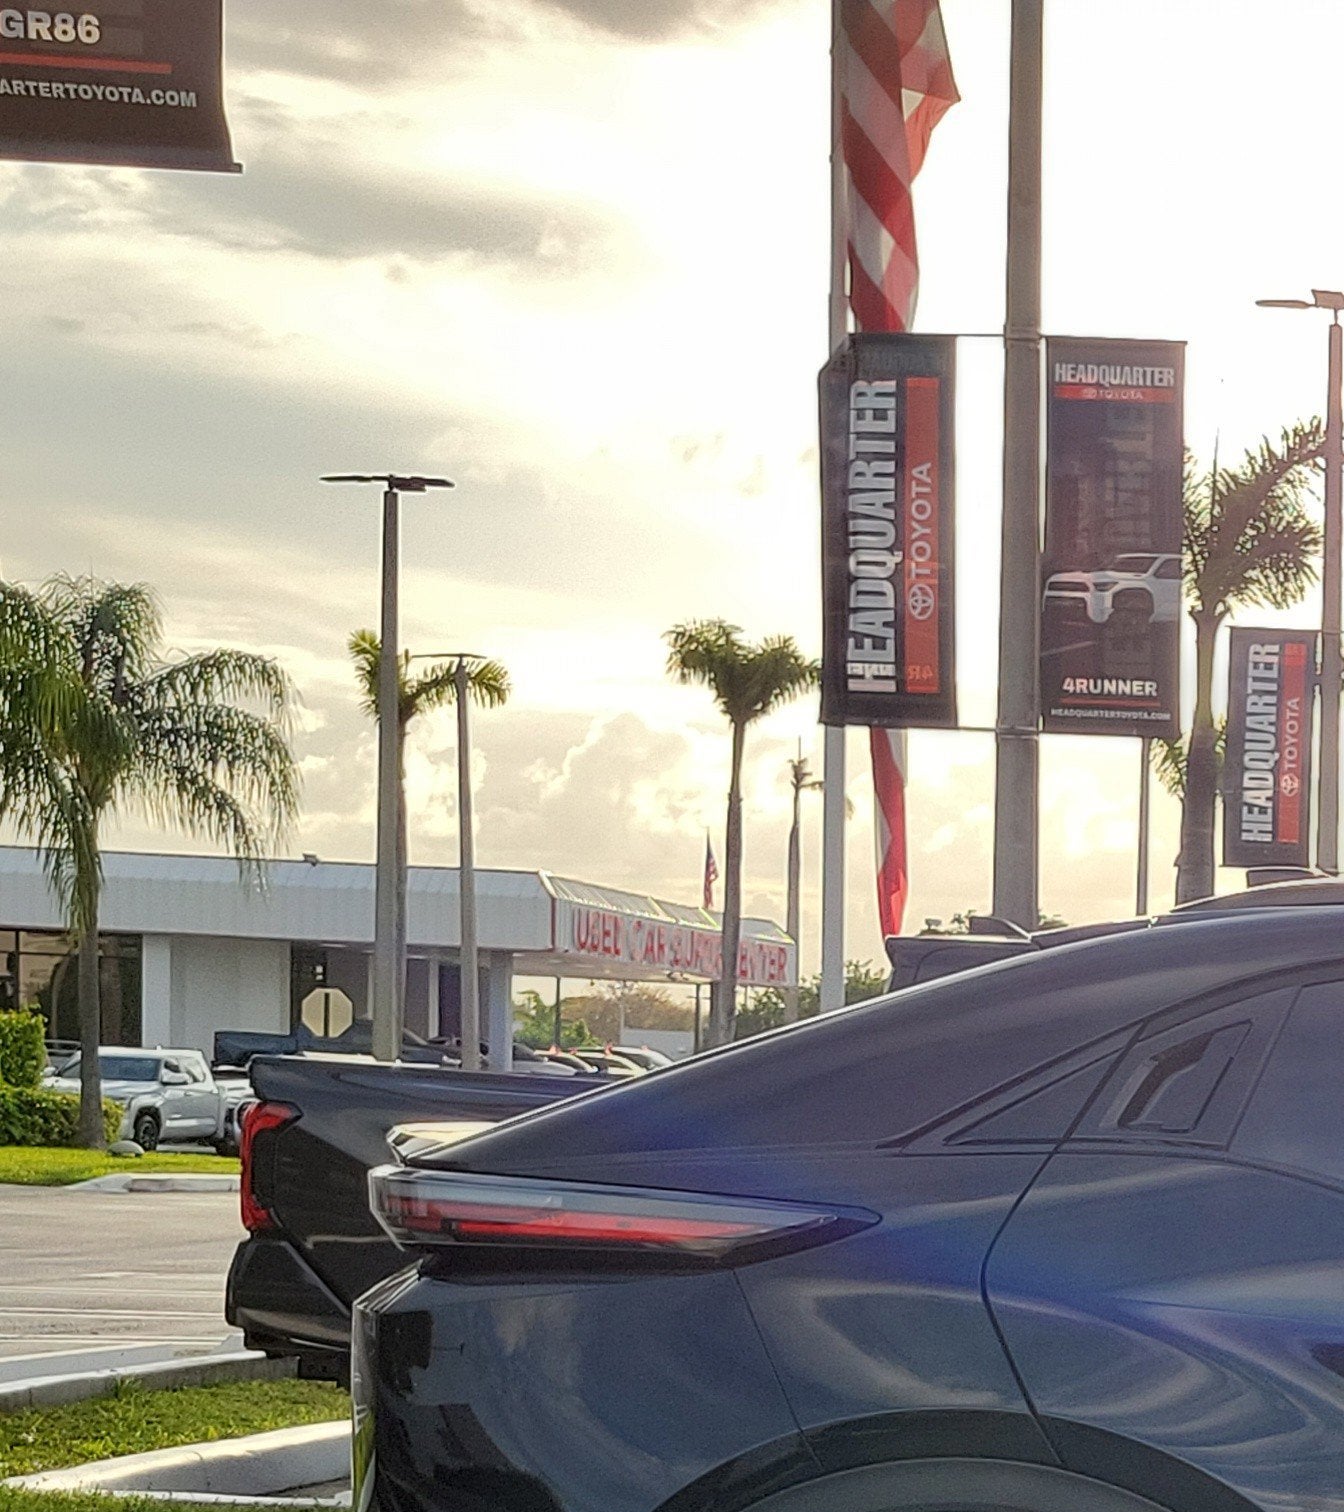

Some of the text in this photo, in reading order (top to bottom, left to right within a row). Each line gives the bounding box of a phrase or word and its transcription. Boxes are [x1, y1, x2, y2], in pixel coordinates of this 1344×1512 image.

[0, 9, 101, 44] GR86
[1055, 363, 1175, 387] HEADQUARTER
[847, 379, 902, 693] HEADQUARTER
[910, 462, 934, 578] TOYOTA
[1062, 677, 1158, 696] 4RUNNER
[1241, 643, 1280, 843] HEADQUARTER
[1283, 697, 1301, 770] TOYOTA
[738, 941, 788, 982] ENTER
